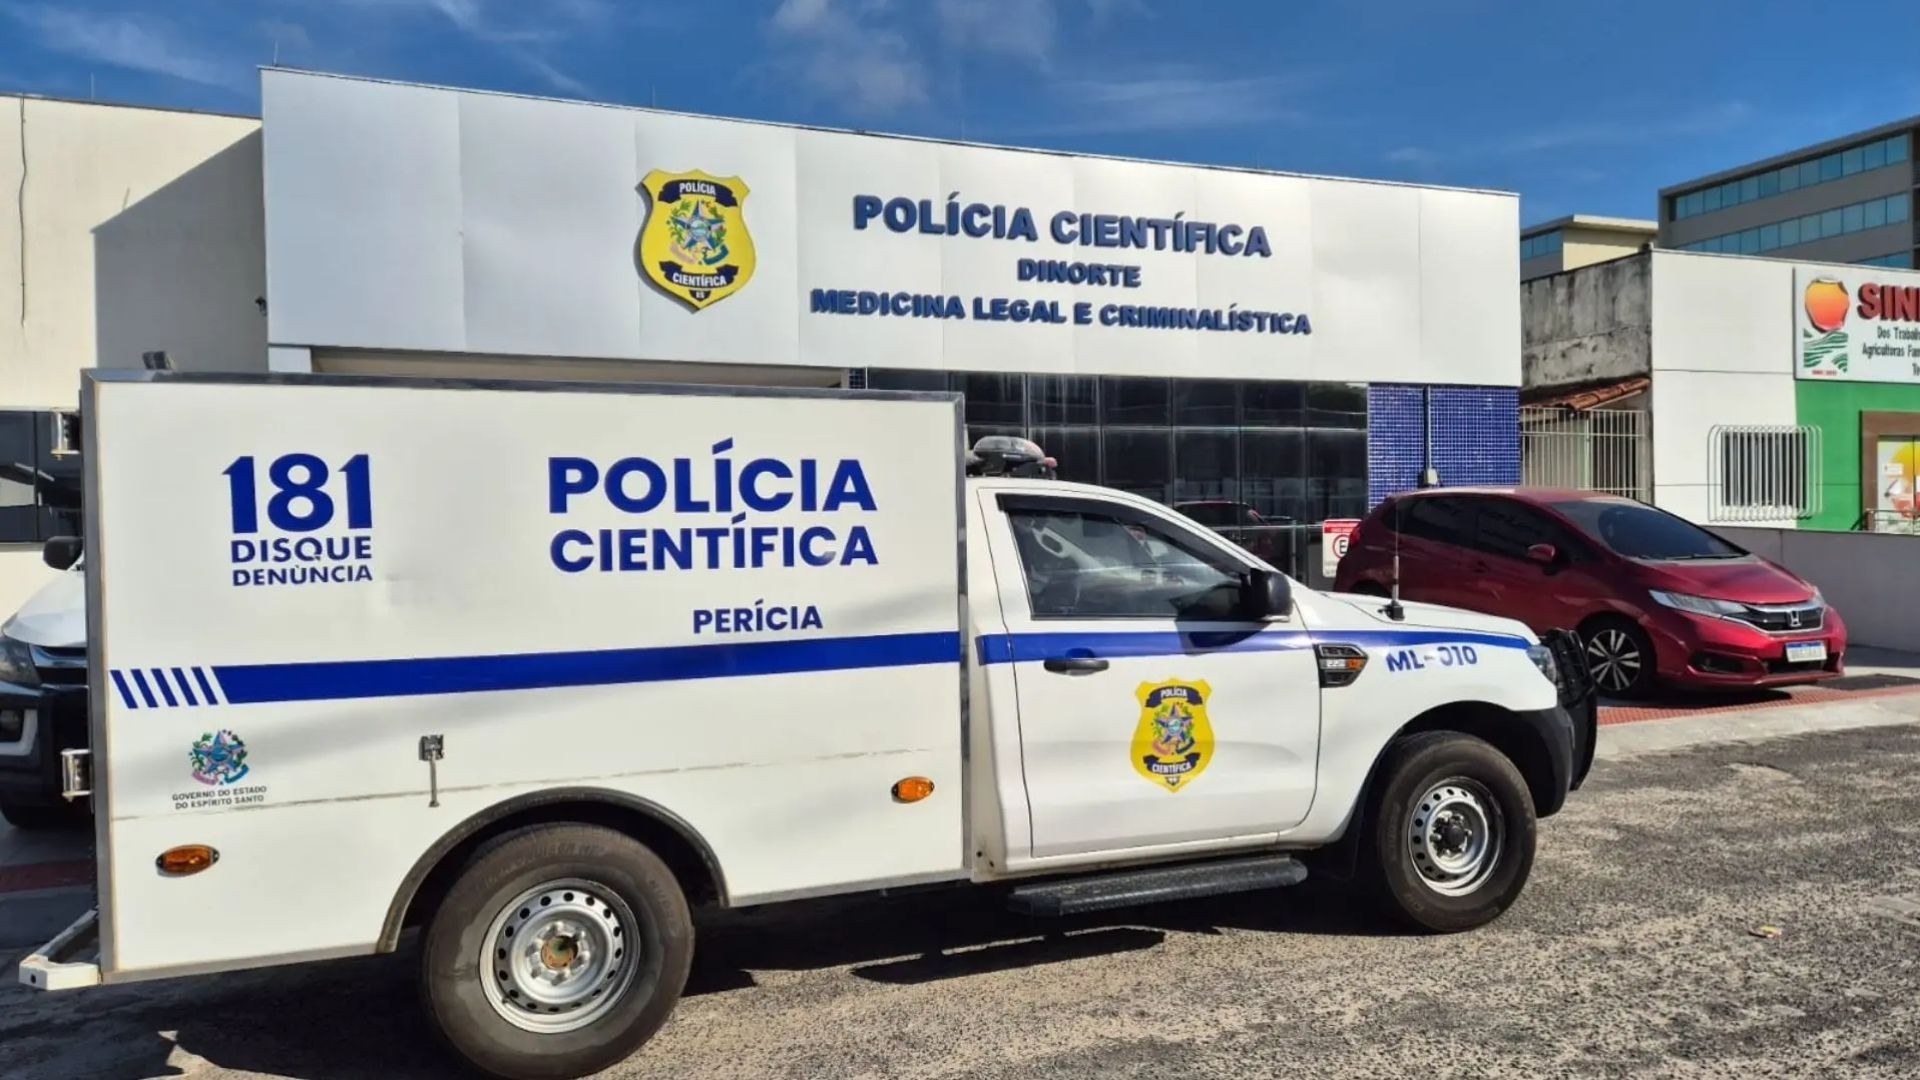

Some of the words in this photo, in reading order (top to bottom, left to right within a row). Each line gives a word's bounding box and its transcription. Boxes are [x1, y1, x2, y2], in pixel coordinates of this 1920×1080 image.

[680, 181, 716, 195] POLÍCIA
[853, 191, 1038, 242] POLÍCIA
[1050, 211, 1272, 257] CIENTÍFICA
[672, 272, 727, 287] CIENTÍFICA
[1017, 258, 1141, 288] DINORTE
[810, 289, 966, 319] MEDICINA
[973, 297, 1067, 323] LEGAL
[1073, 302, 1093, 325] E
[1099, 303, 1312, 335] CRIMINALÍSTICA
[1857, 282, 1920, 322] SIN
[1877, 325, 1891, 339] Dos
[548, 437, 878, 514] POLÍCIA
[222, 453, 372, 534] 181
[231, 536, 372, 563] DISQUE
[550, 511, 879, 573] CIENTÍFICA
[693, 599, 823, 634] PERÍCIA
[1160, 687, 1188, 699] POLÍCIA
[172, 791, 215, 801] GOVERNO
[218, 789, 230, 797] DO
[233, 786, 267, 795] ESTADO
[175, 801, 188, 810] DO
[191, 798, 232, 808] ESPÍRITO
[235, 795, 264, 804] SANTO
